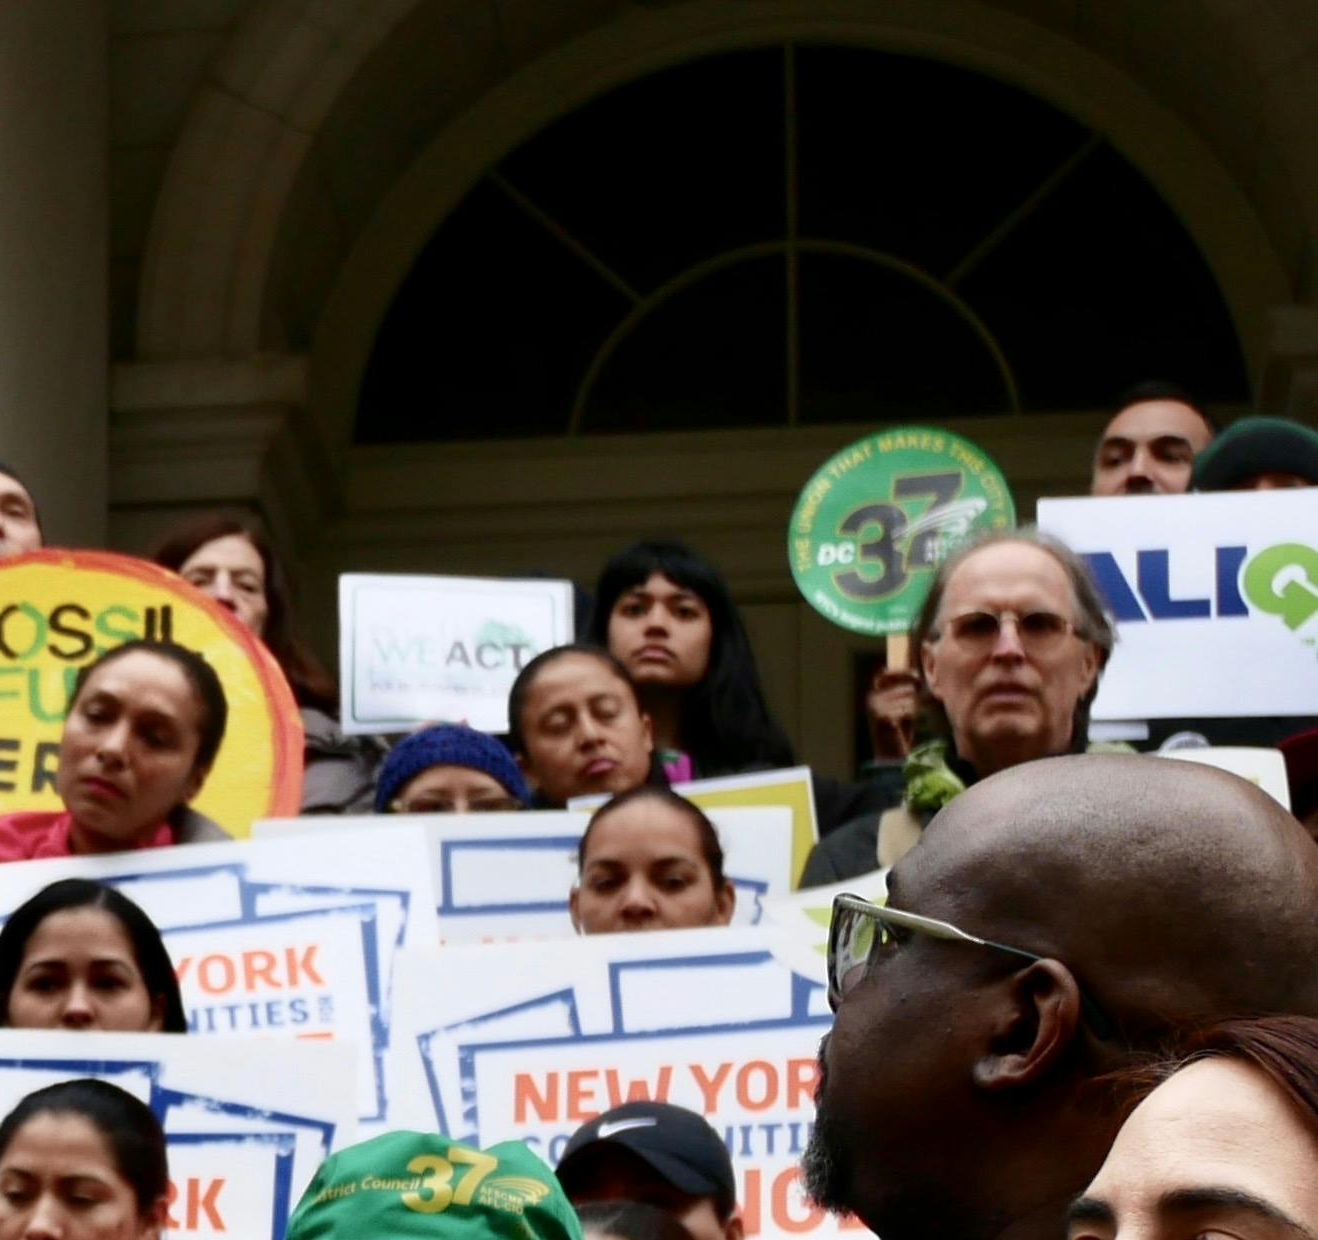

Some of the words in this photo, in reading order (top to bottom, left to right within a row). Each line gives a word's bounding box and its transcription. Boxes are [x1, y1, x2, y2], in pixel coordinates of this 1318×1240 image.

[877, 432, 946, 454] MAKES
[816, 541, 856, 567] DC
[444, 639, 532, 671] ACT
[513, 1065, 673, 1123] NEW
[689, 1058, 822, 1115] YOR
[360, 1175, 421, 1192] Council
[401, 1144, 499, 1213] 37
